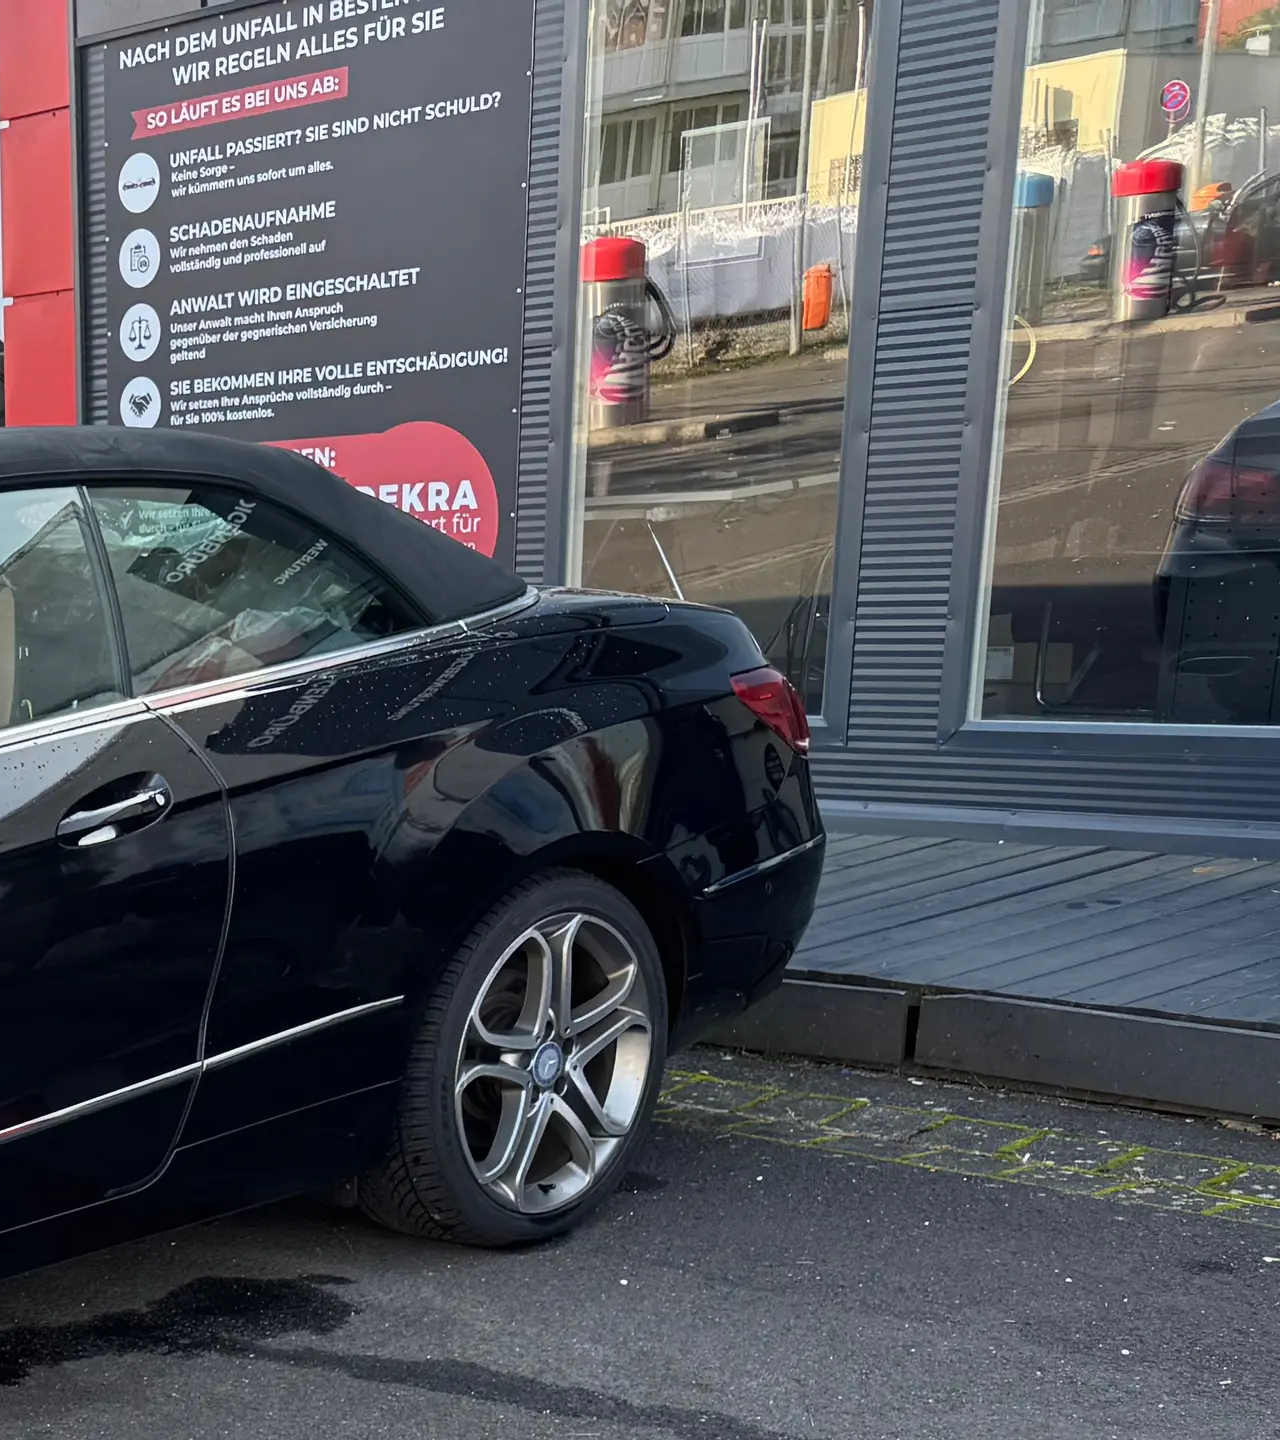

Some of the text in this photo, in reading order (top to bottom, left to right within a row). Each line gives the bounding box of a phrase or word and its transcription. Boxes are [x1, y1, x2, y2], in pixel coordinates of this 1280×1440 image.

[119, 39, 170, 70] NACH
[175, 28, 217, 57] DEM
[222, 16, 298, 46] UNFALL
[303, 3, 324, 27] IN
[172, 7, 445, 86] WIR REGELN ALLES FÜR SIE
[147, 75, 339, 130] SO LÄUFT ES BEI UNS AB:
[170, 91, 502, 168] UNFALL PASSIERT? SIE SIND NICHT SCHULD?
[171, 169, 198, 183] Keine
[199, 164, 228, 178] Sorge
[171, 160, 334, 198] wir kümmern uns sofort um alles.
[169, 200, 336, 243] SCHADENAUFNAHME
[169, 231, 294, 259] Wir nehmen den Schaden
[169, 239, 326, 274] vollständig und professionell auf
[169, 267, 421, 316] ANWALT WIRD EINGESCHALTET
[169, 315, 378, 351] gegenüber der gegnerischen Versicherung
[170, 301, 344, 334] Unser Anwalt macht Ihren Anspruch
[169, 346, 206, 365] geltend
[170, 347, 508, 396] SIE BEKOMMEN IHRE VOLLE ENTSCHÄDIGUNG!
[170, 399, 187, 412] Wir
[188, 398, 220, 411] setzen
[220, 395, 240, 407] Ihre
[241, 390, 294, 406] Ansprüche
[295, 384, 351, 401] vollständig
[352, 381, 384, 395] durch
[170, 407, 275, 426] für Sie 100% kostenlos.
[452, 512, 481, 534] für
